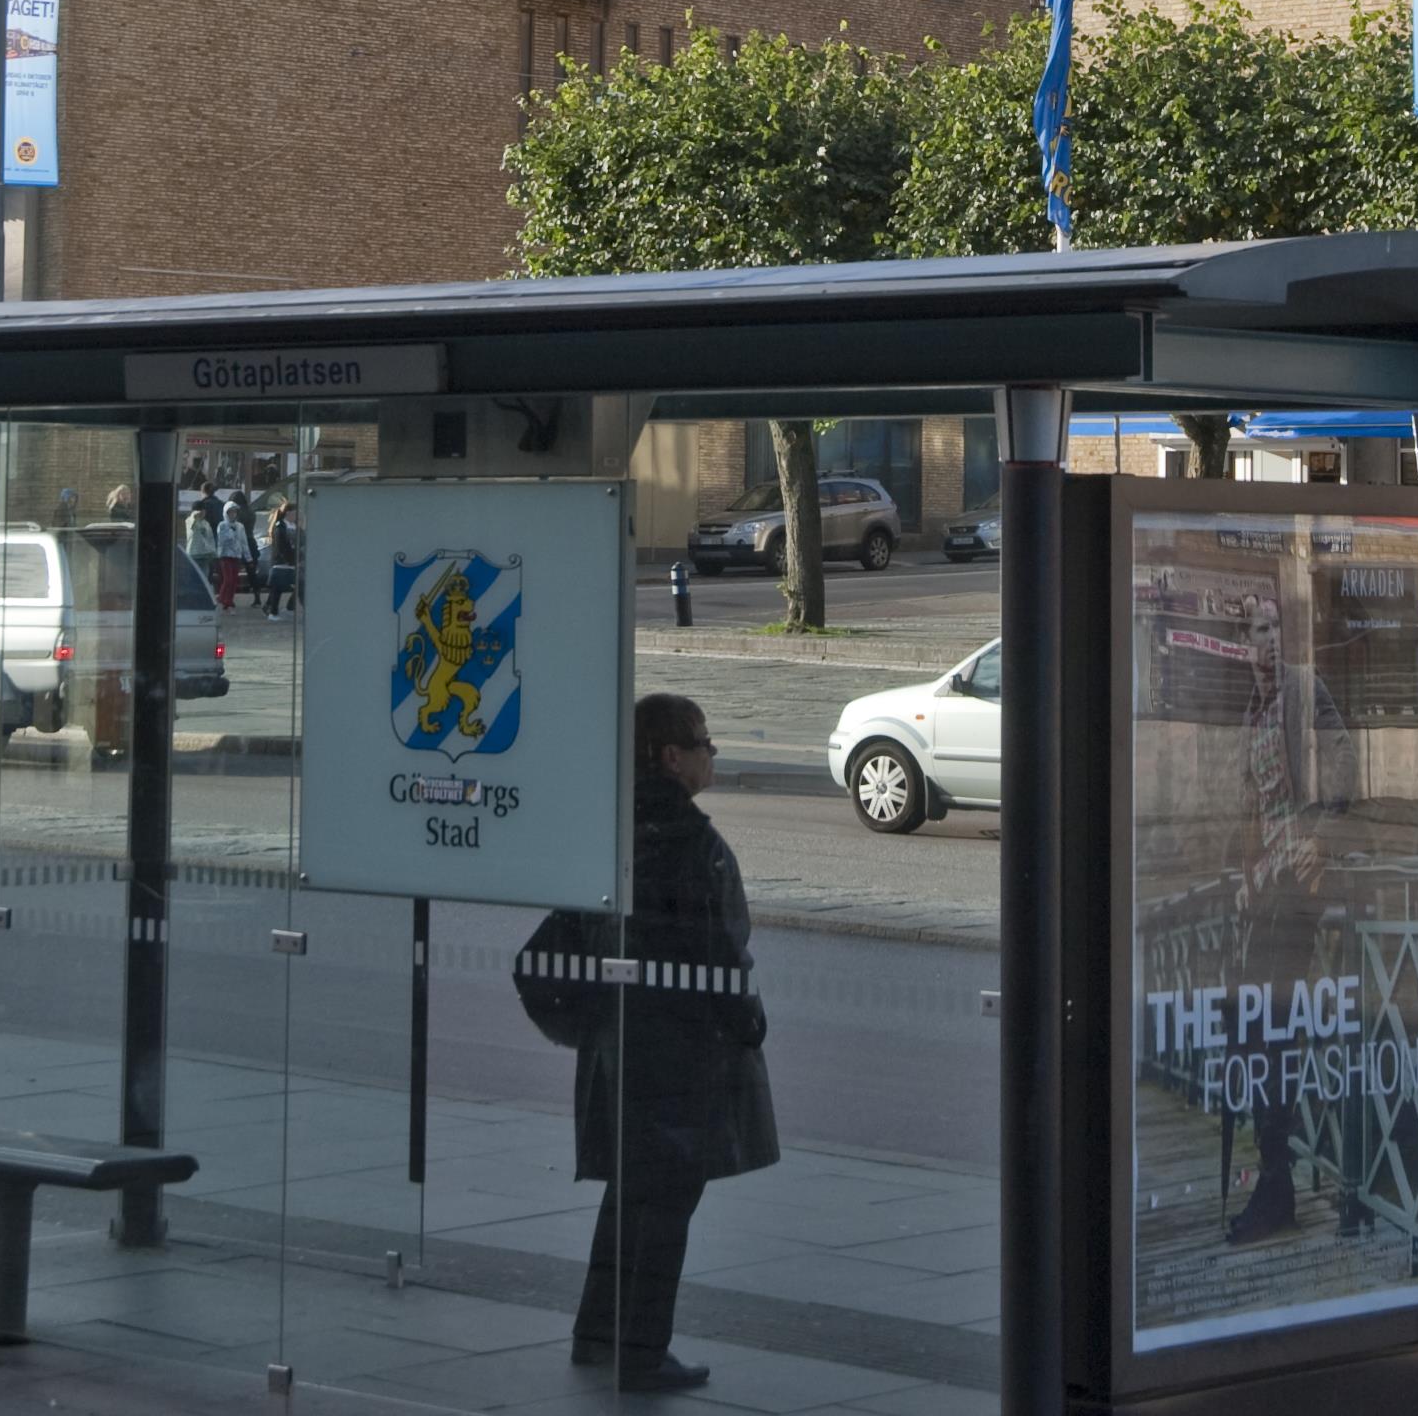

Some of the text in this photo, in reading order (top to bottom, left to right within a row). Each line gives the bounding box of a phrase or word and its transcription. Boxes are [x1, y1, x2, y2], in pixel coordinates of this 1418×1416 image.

[193, 355, 361, 394] Götaplatsen
[1340, 568, 1405, 597] ARKADEN
[389, 773, 520, 817] Görgs
[425, 815, 481, 849] Stad
[1147, 975, 1361, 1053] THE PLACE
[1203, 1053, 1270, 1114] FOR
